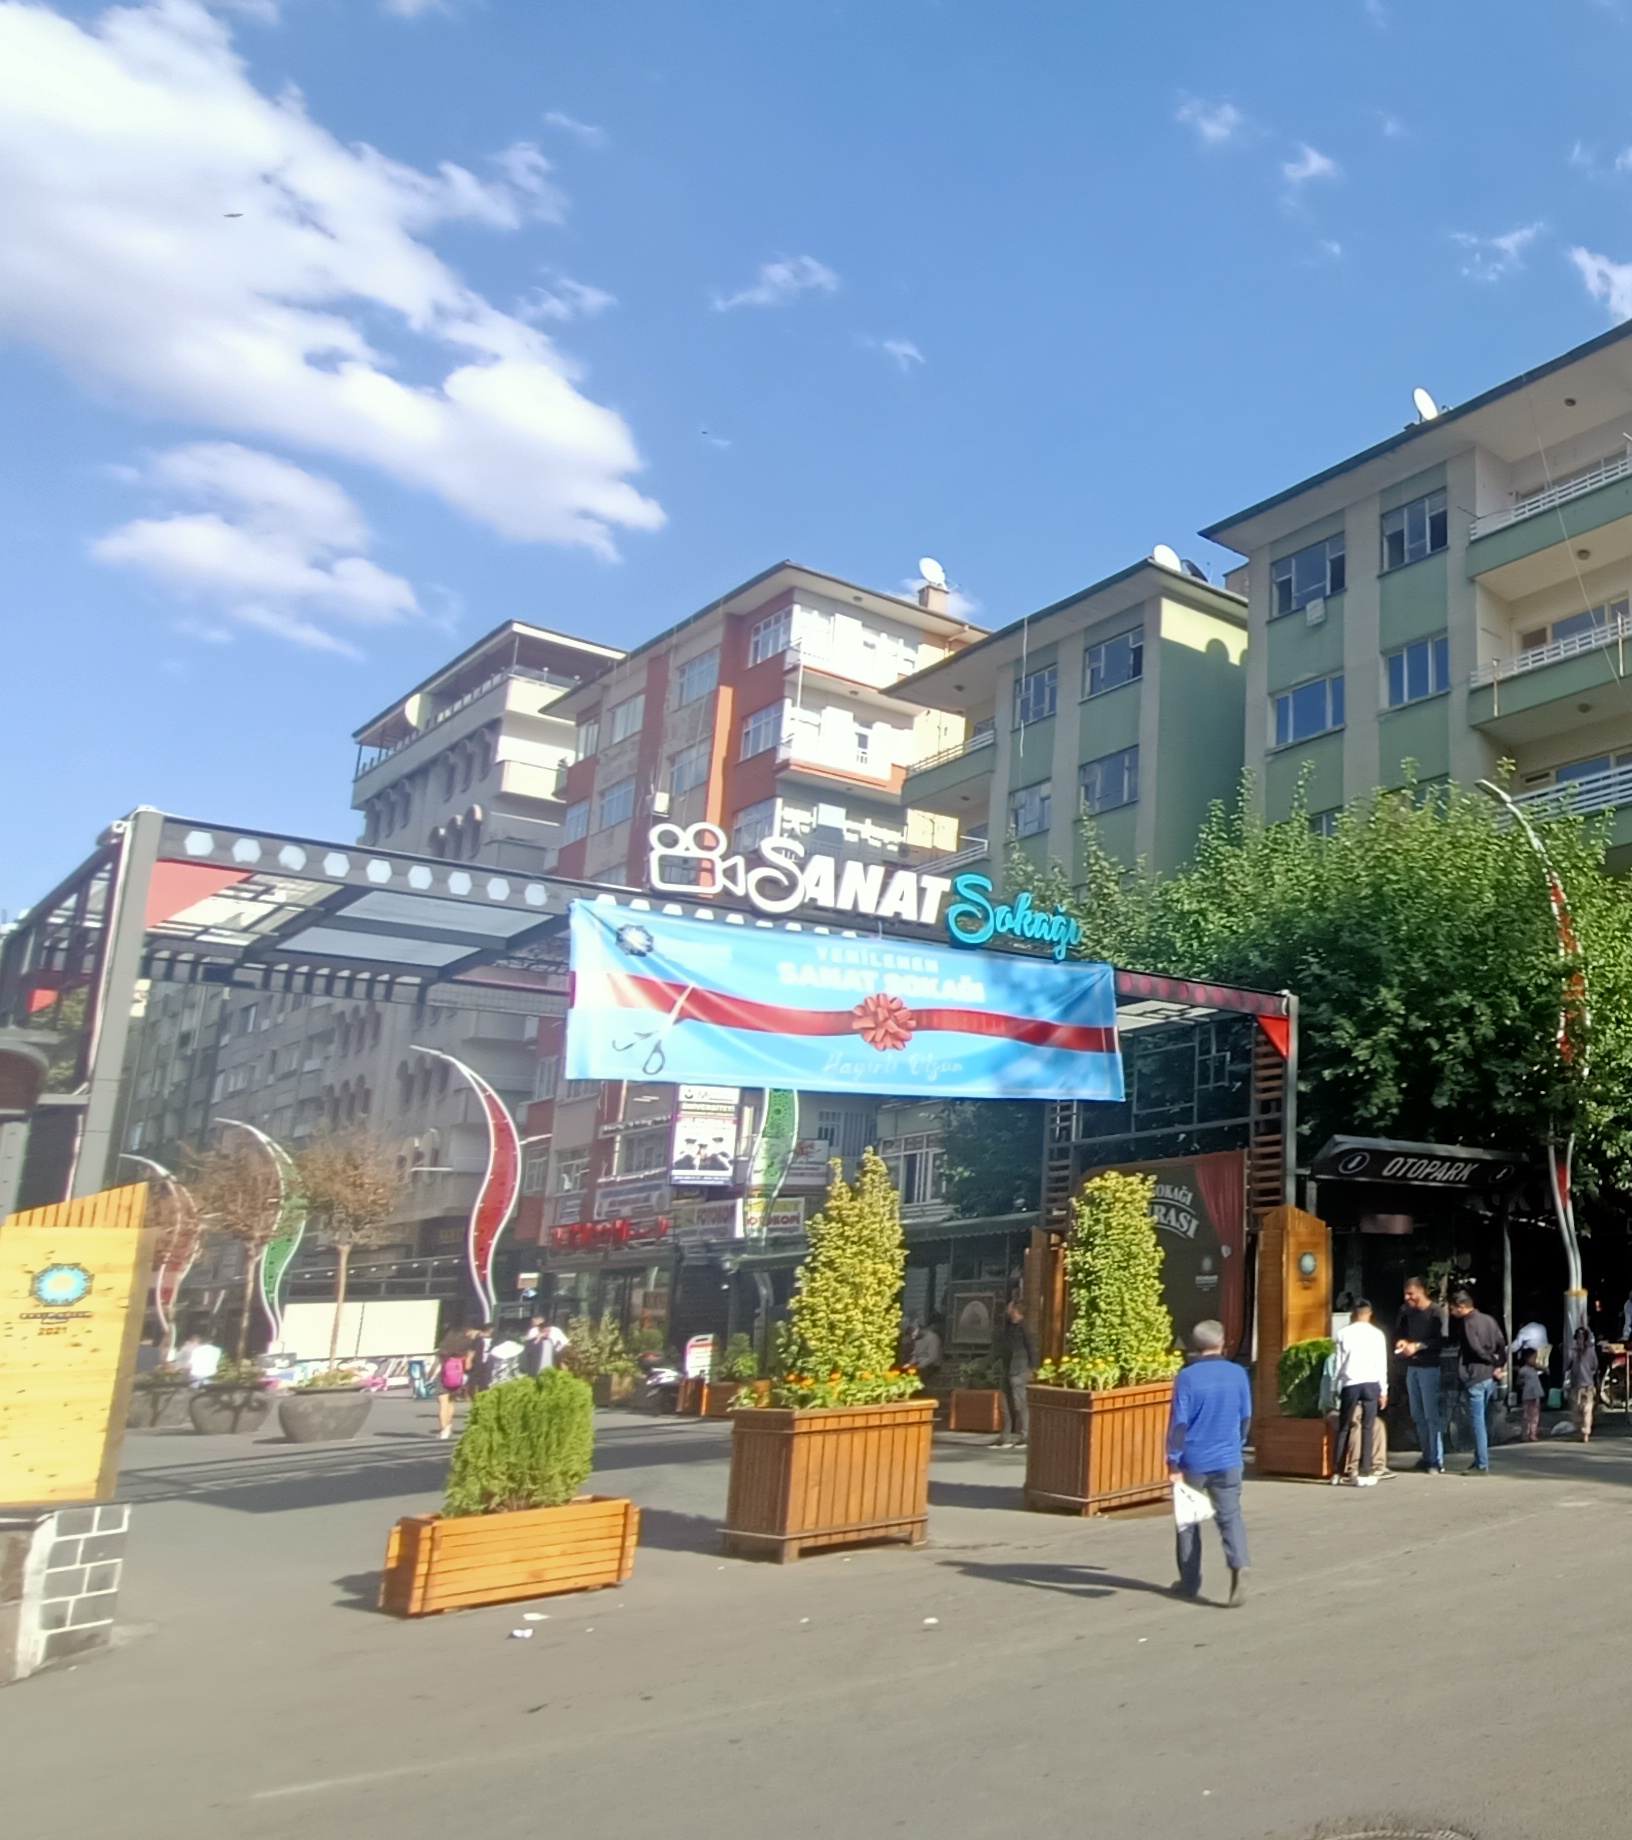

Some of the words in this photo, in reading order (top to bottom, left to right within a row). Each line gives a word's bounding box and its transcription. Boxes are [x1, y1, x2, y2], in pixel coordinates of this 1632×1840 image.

[747, 836, 951, 924] SANAT
[945, 873, 1084, 961] Sokağı
[816, 946, 940, 973] YENİLENEN
[778, 962, 879, 992] SANAT
[883, 971, 985, 1004] SOKAĞI
[1382, 1157, 1480, 1182] OTOPARK
[1154, 1184, 1194, 1206] OKAĞI
